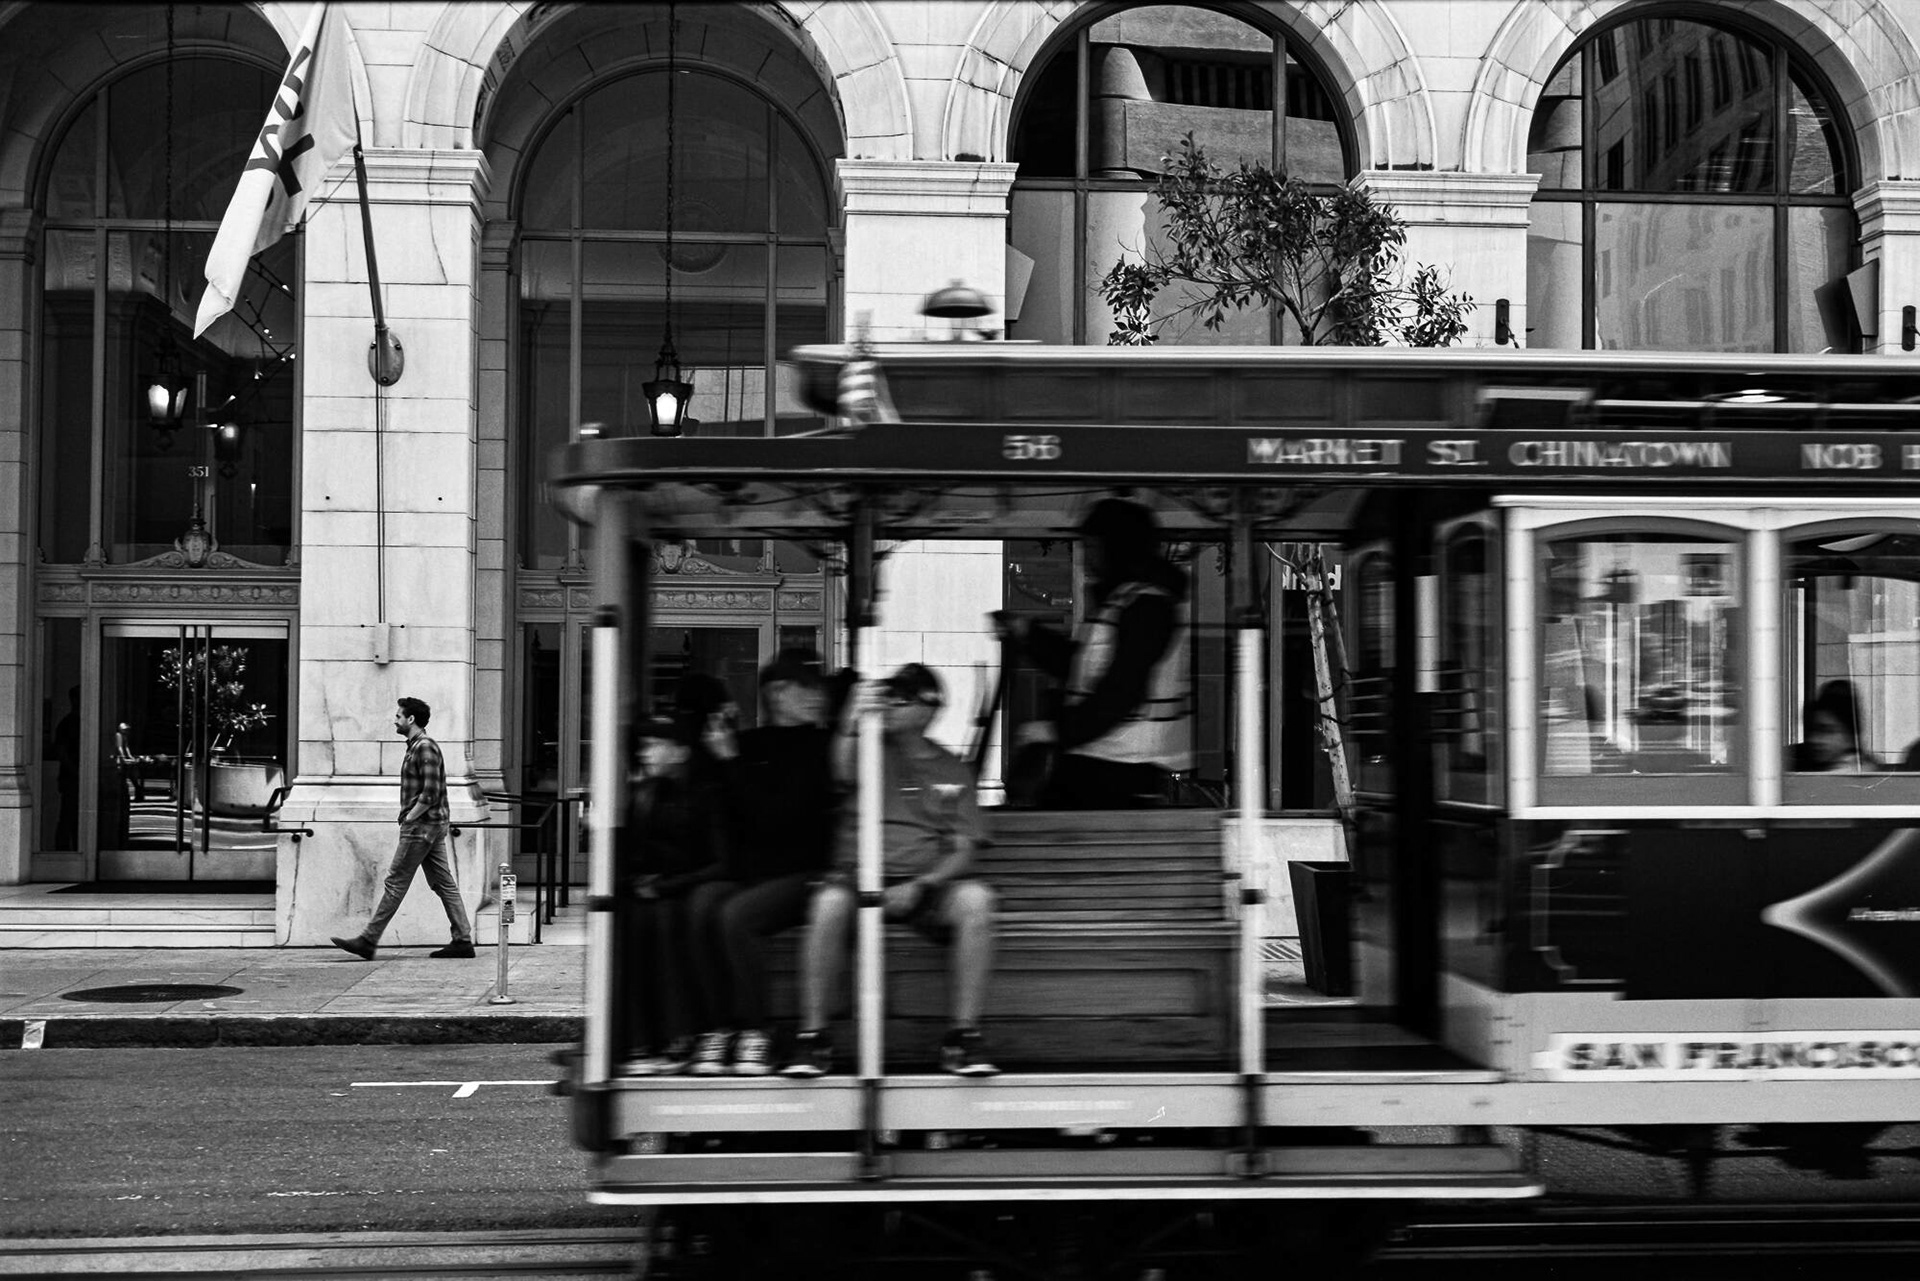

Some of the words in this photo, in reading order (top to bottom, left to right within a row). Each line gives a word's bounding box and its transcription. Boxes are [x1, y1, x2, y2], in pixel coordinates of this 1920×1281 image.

[1003, 435, 1062, 460] 56
[1247, 438, 1405, 465] MARKET
[1508, 441, 1732, 467] CHINATOWN
[1801, 444, 1883, 470] NOB
[188, 466, 209, 478] 351
[1567, 1043, 1665, 1070] SAN
[1679, 1042, 1920, 1069] FRANCISC
